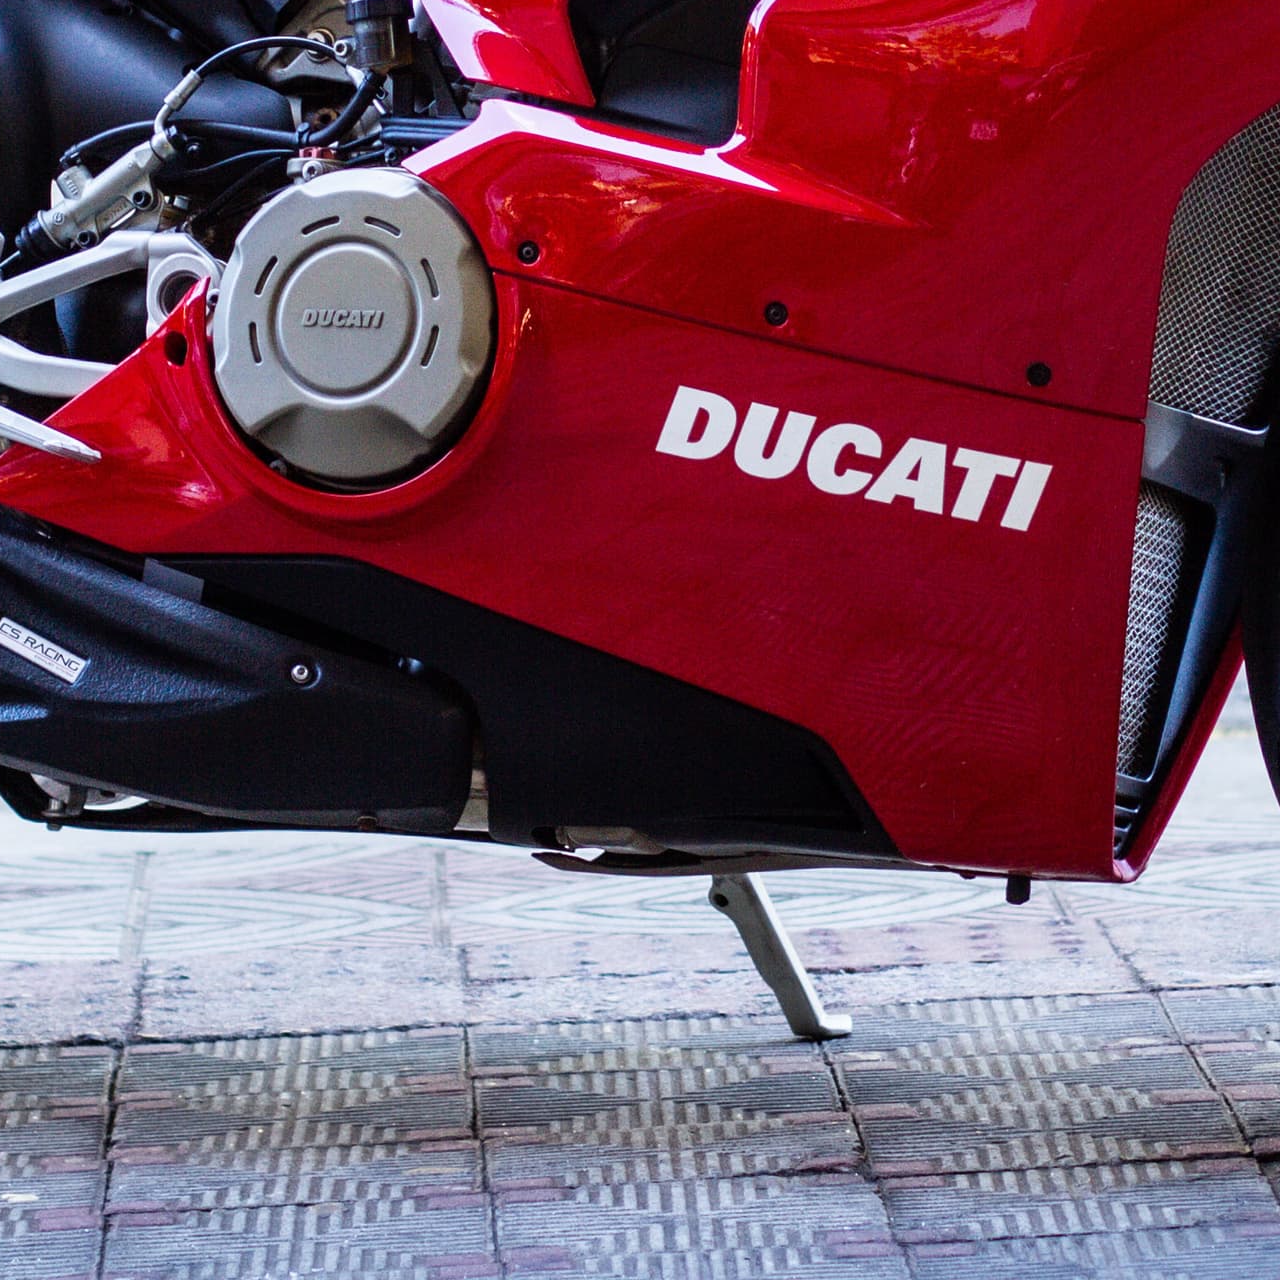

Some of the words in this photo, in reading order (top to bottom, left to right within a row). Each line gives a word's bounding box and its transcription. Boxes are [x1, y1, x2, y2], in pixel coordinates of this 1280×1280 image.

[302, 308, 384, 329] DUCATI
[655, 385, 1053, 532] DUCATI
[0, 622, 22, 640] CS
[23, 636, 80, 672] RACING
